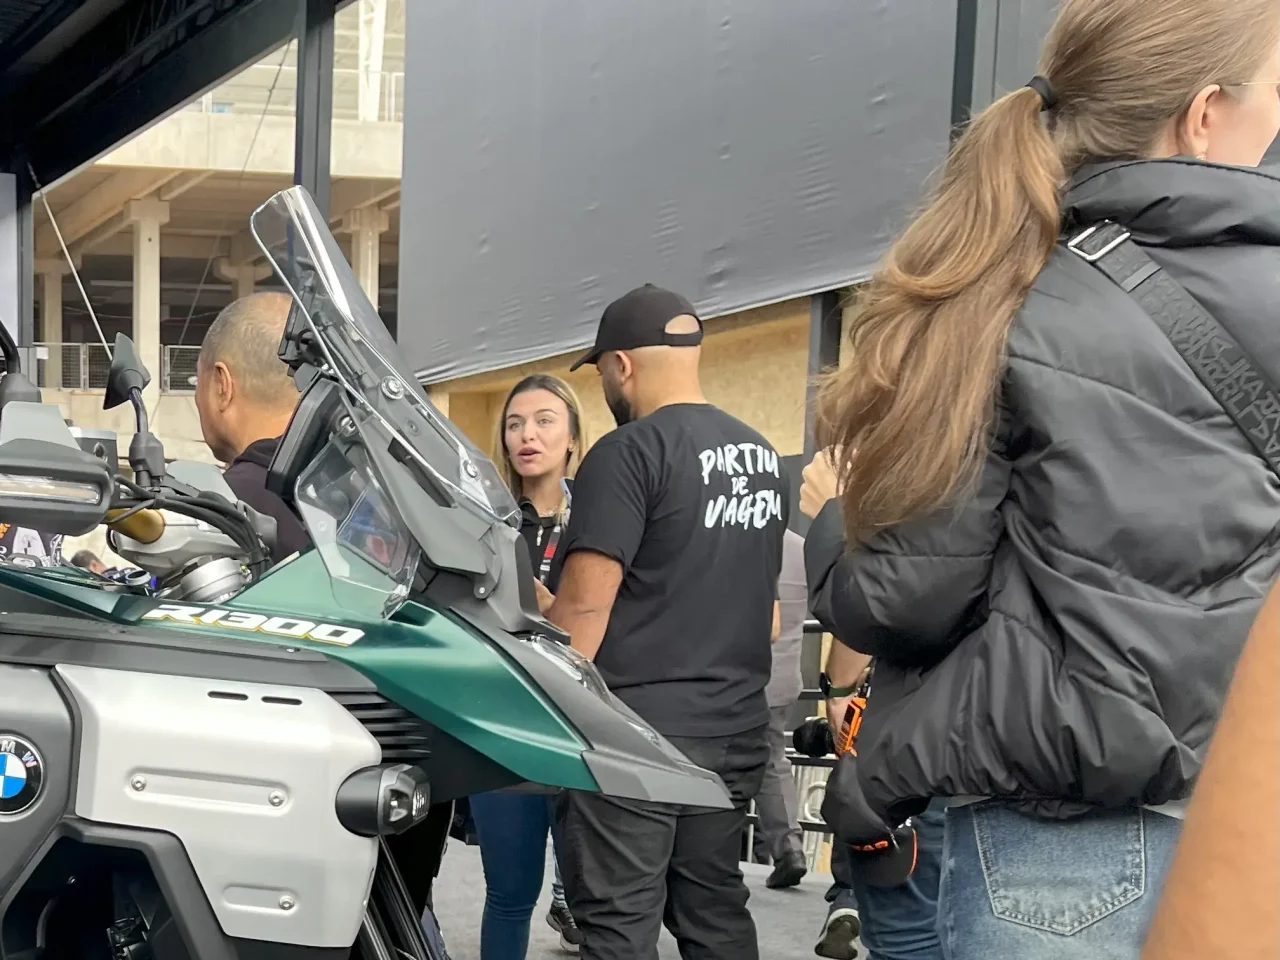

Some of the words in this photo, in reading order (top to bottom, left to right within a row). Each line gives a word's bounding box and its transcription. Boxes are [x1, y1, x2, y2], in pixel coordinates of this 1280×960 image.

[698, 442, 780, 485] PARTIU
[731, 475, 749, 496] DE
[704, 489, 783, 530] VIAGEM
